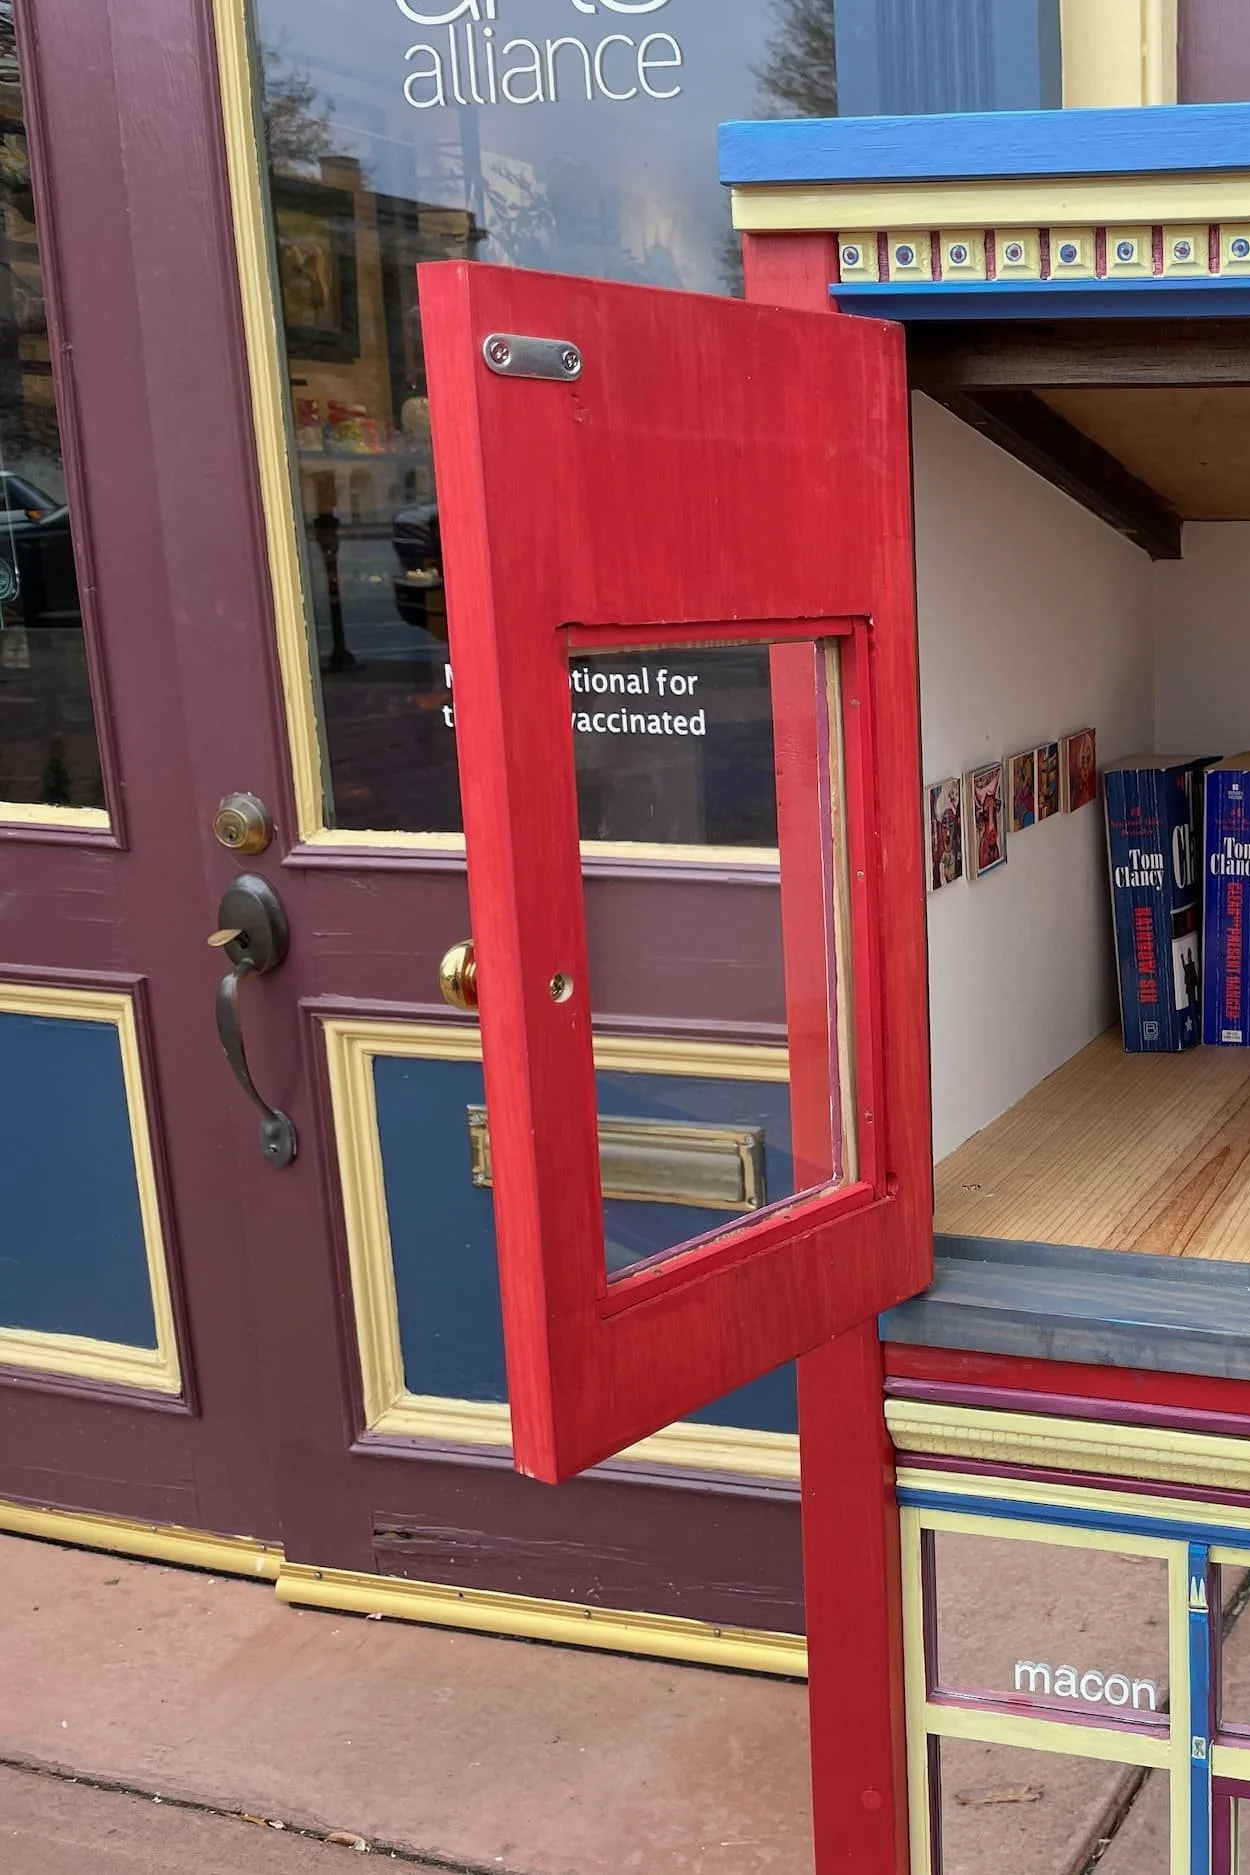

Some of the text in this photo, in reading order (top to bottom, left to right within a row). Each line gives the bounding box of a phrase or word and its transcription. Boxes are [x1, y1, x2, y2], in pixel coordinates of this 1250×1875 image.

[403, 22, 682, 108] alliance
[568, 667, 698, 696] tional for
[1129, 849, 1164, 871] Tom
[1115, 866, 1165, 891] Clancy
[1013, 1660, 1157, 1711] macon
